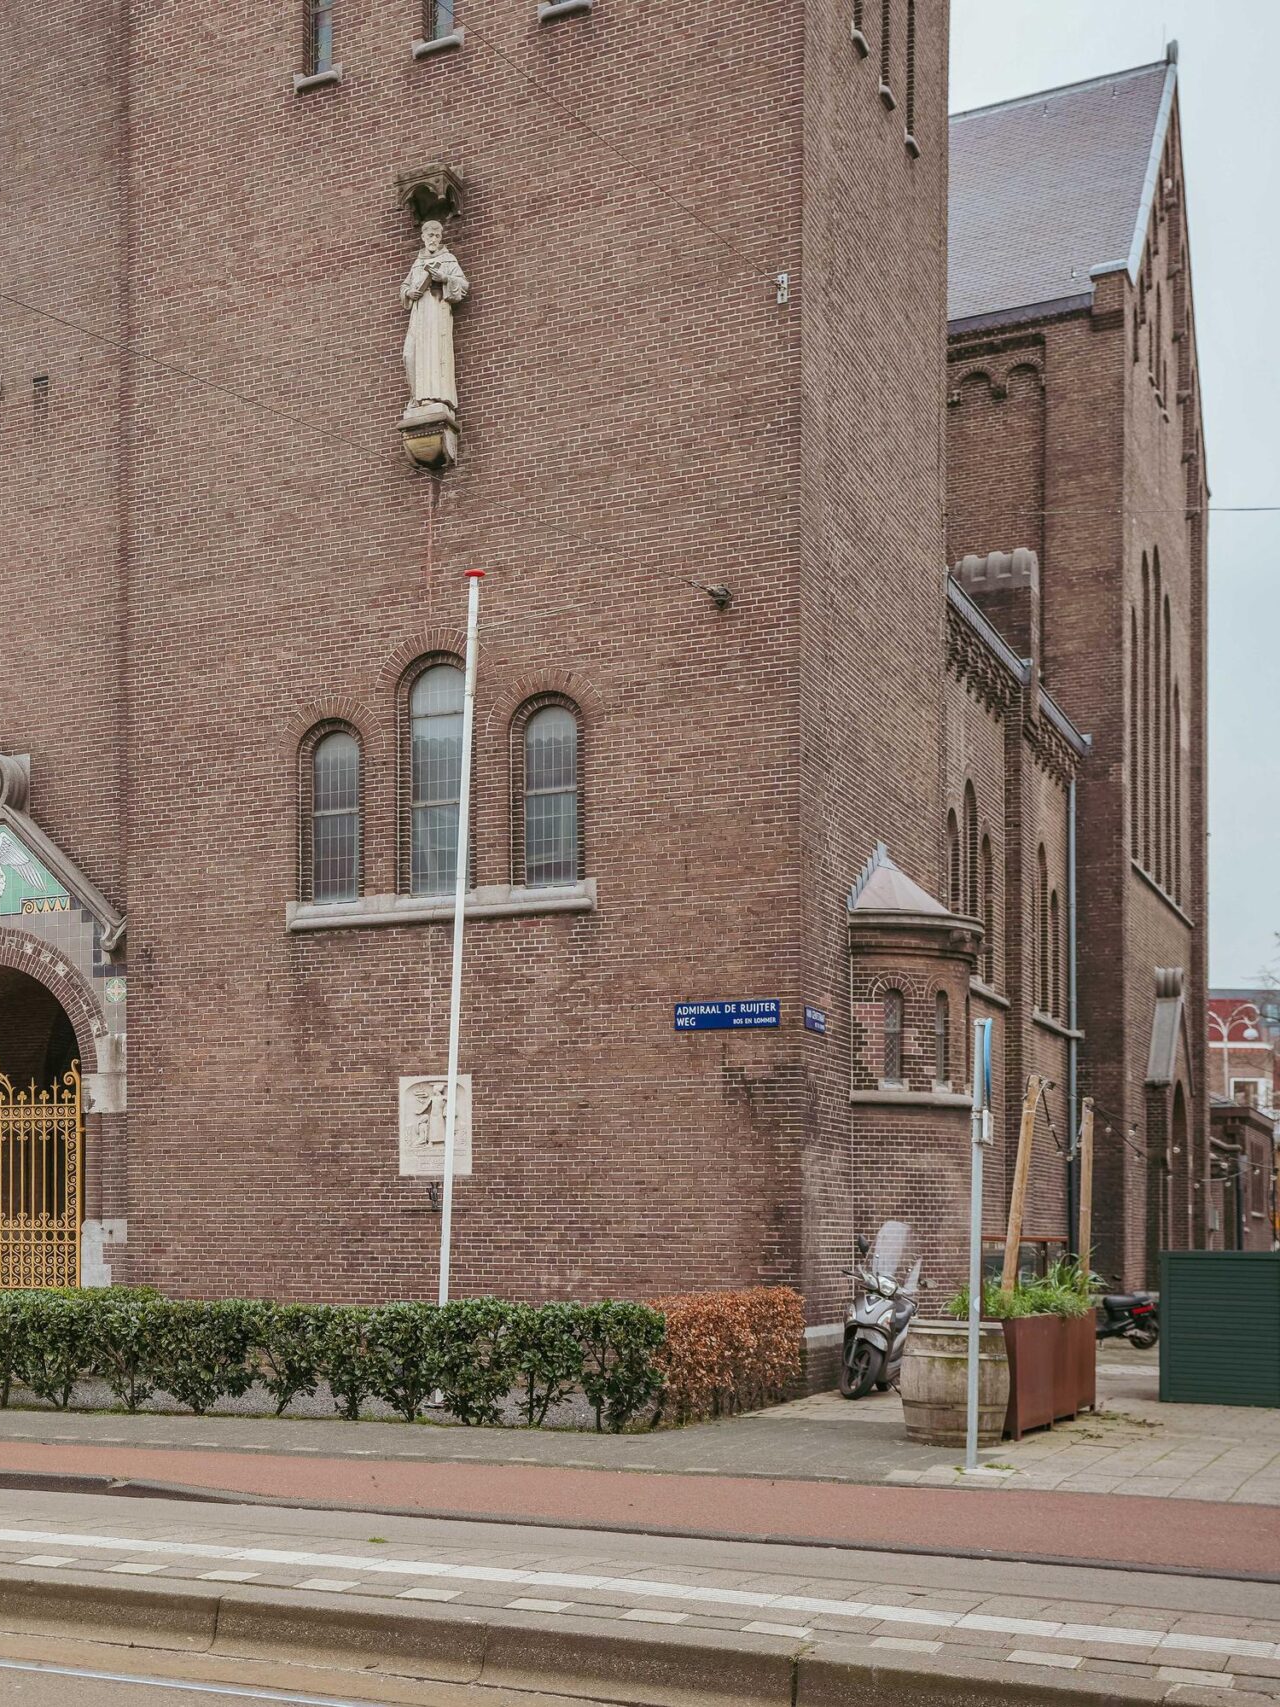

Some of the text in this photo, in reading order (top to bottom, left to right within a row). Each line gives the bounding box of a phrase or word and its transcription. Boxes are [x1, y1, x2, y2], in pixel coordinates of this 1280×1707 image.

[677, 1003, 776, 1015] ADMIRAAL DE RUIJTER
[677, 1017, 696, 1026] WEG
